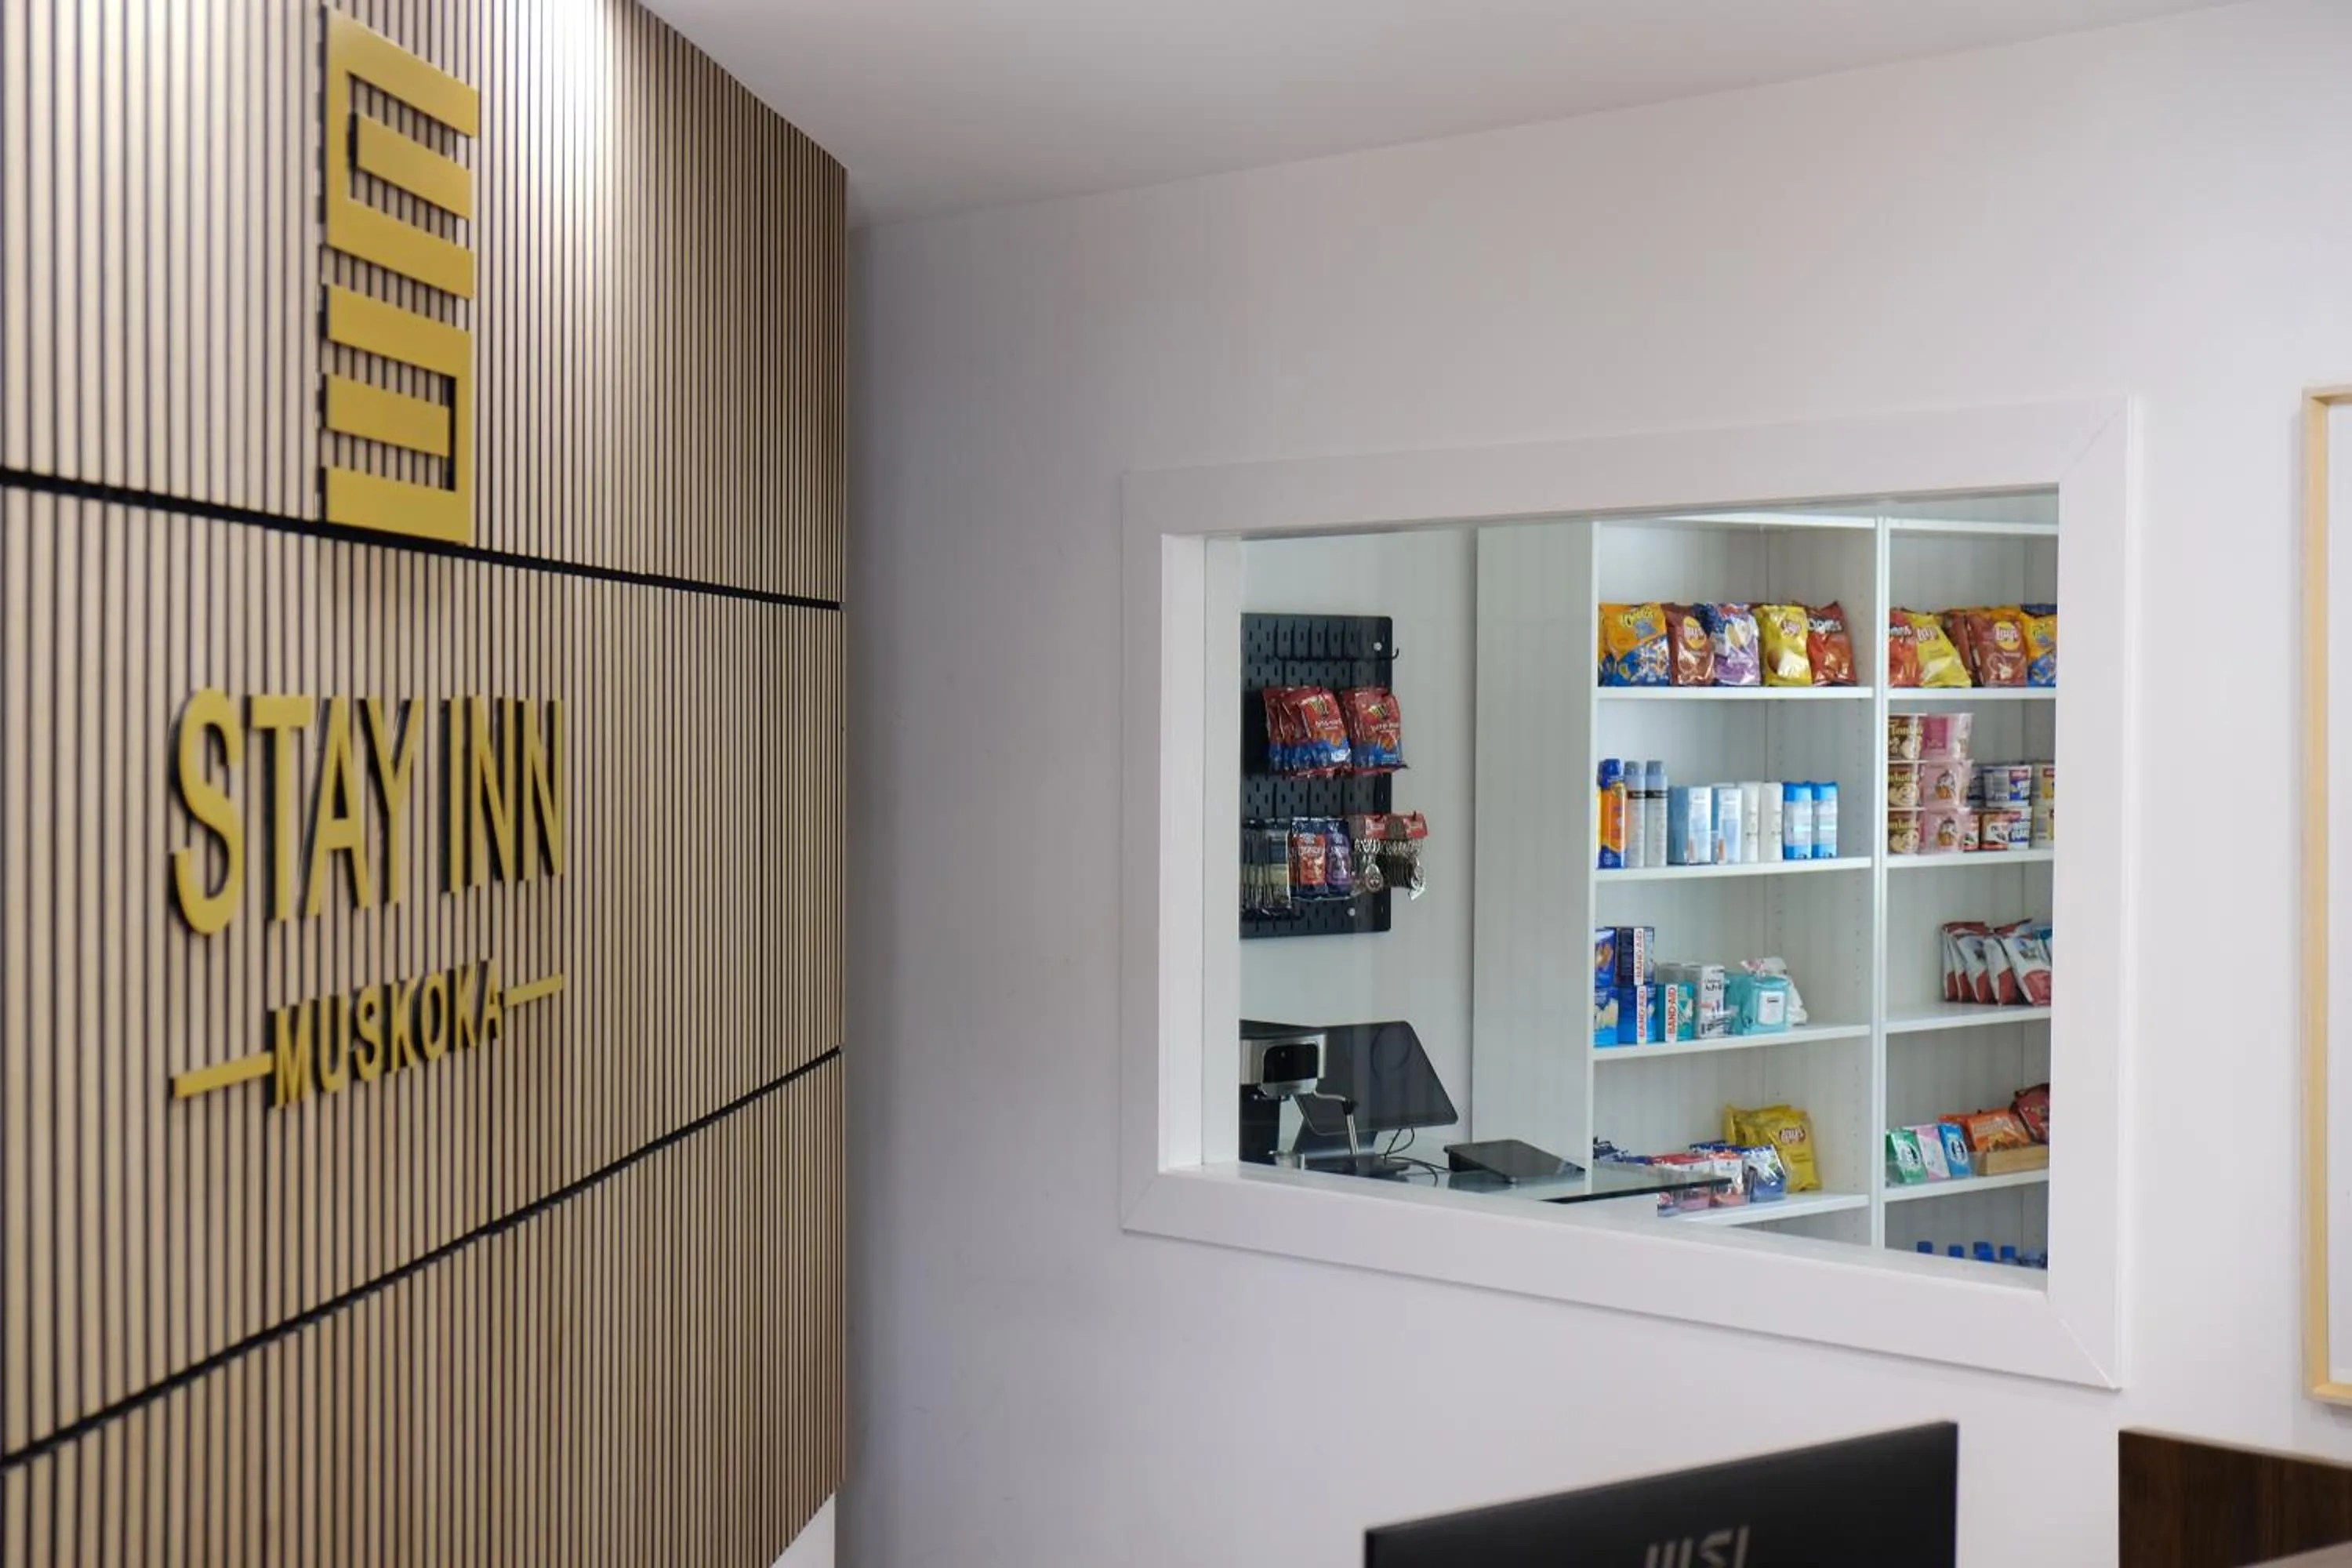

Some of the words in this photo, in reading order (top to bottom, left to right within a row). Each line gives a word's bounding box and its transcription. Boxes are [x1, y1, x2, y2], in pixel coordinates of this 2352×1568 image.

[172, 688, 424, 934] STAY
[448, 695, 564, 894] INN
[273, 957, 505, 1111] MUSKOKA
